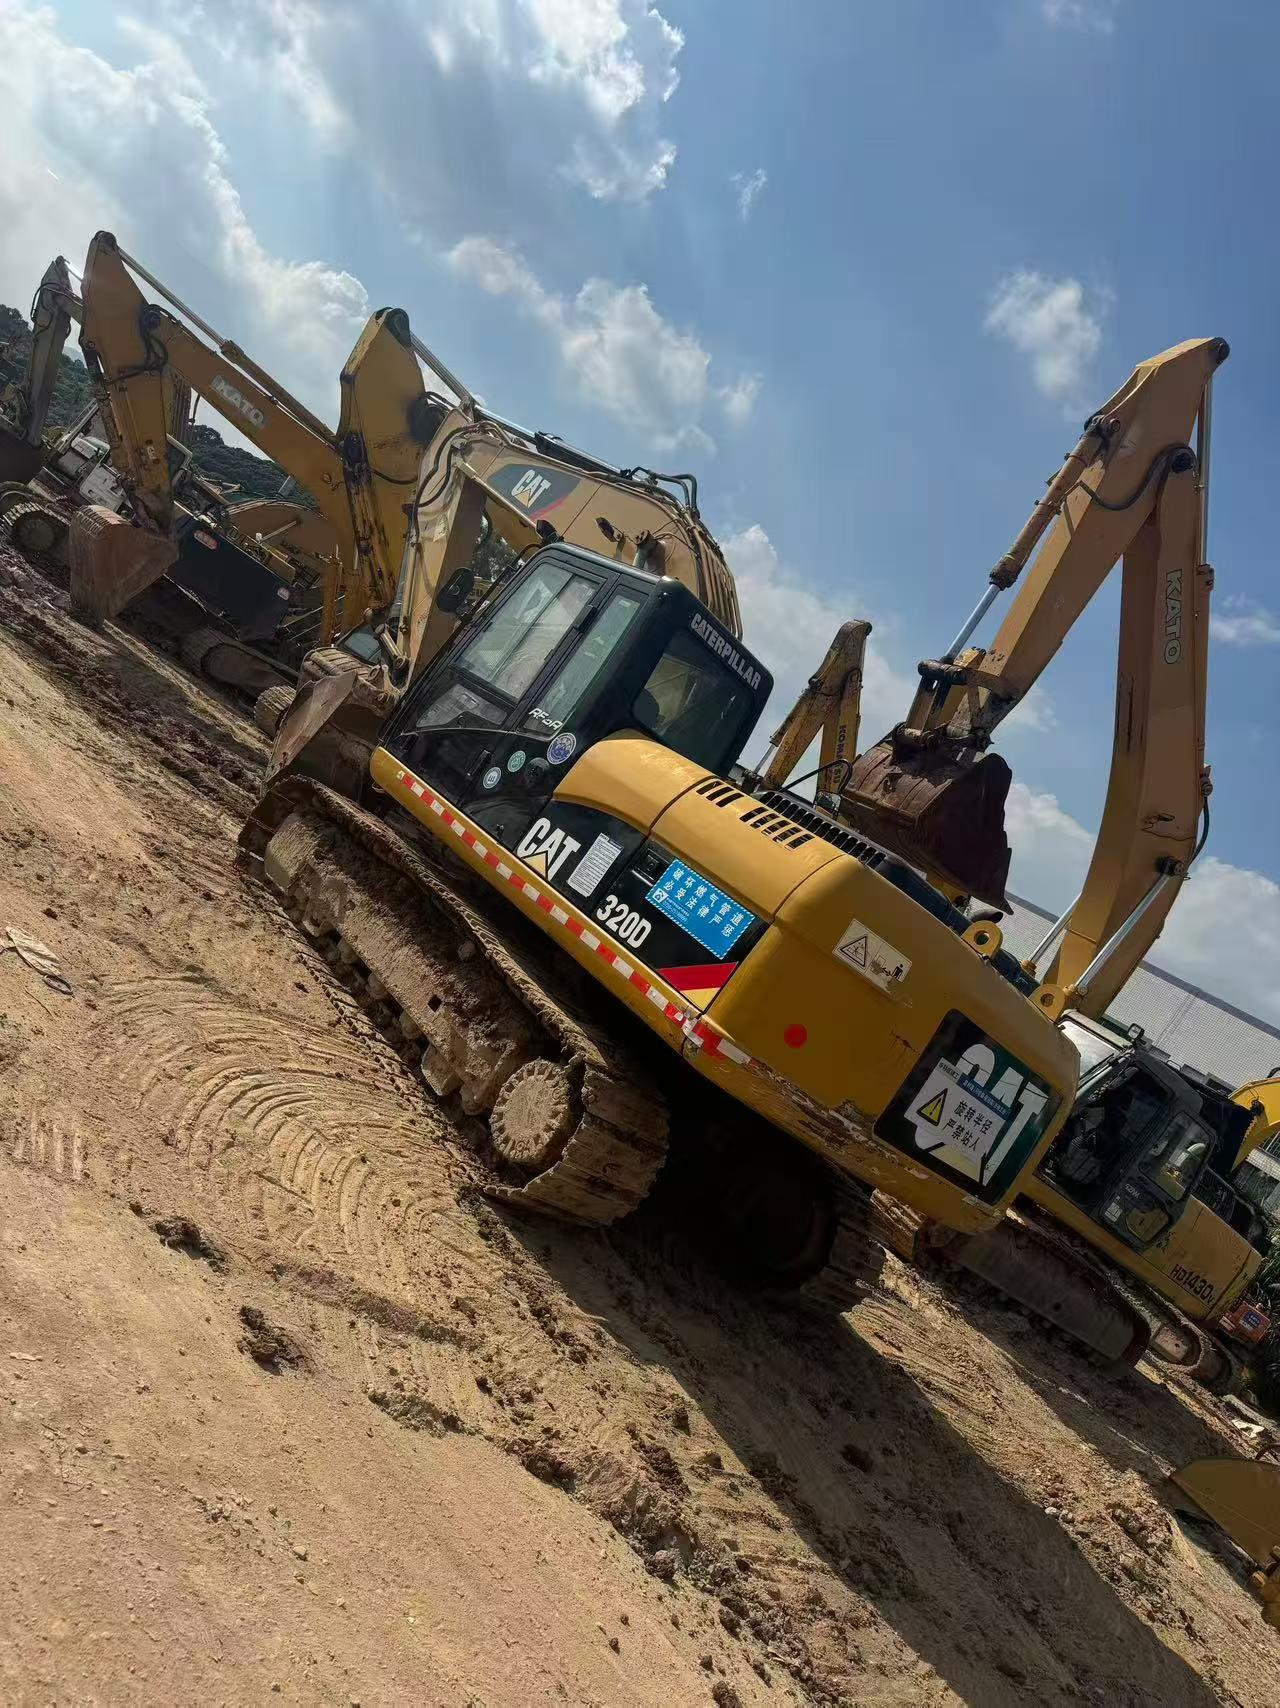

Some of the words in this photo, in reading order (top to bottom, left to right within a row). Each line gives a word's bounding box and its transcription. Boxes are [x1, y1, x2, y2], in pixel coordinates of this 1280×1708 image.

[212, 377, 264, 426] KATO
[511, 469, 552, 509] CAT
[1164, 568, 1183, 665] KATO
[690, 612, 762, 690] CATERPILLAR
[833, 724, 847, 784] KOMASU
[516, 817, 582, 882] CAT
[596, 894, 652, 949] 320D
[942, 1118, 980, 1152] 严禁站人
[953, 1100, 993, 1135] 旋转半径
